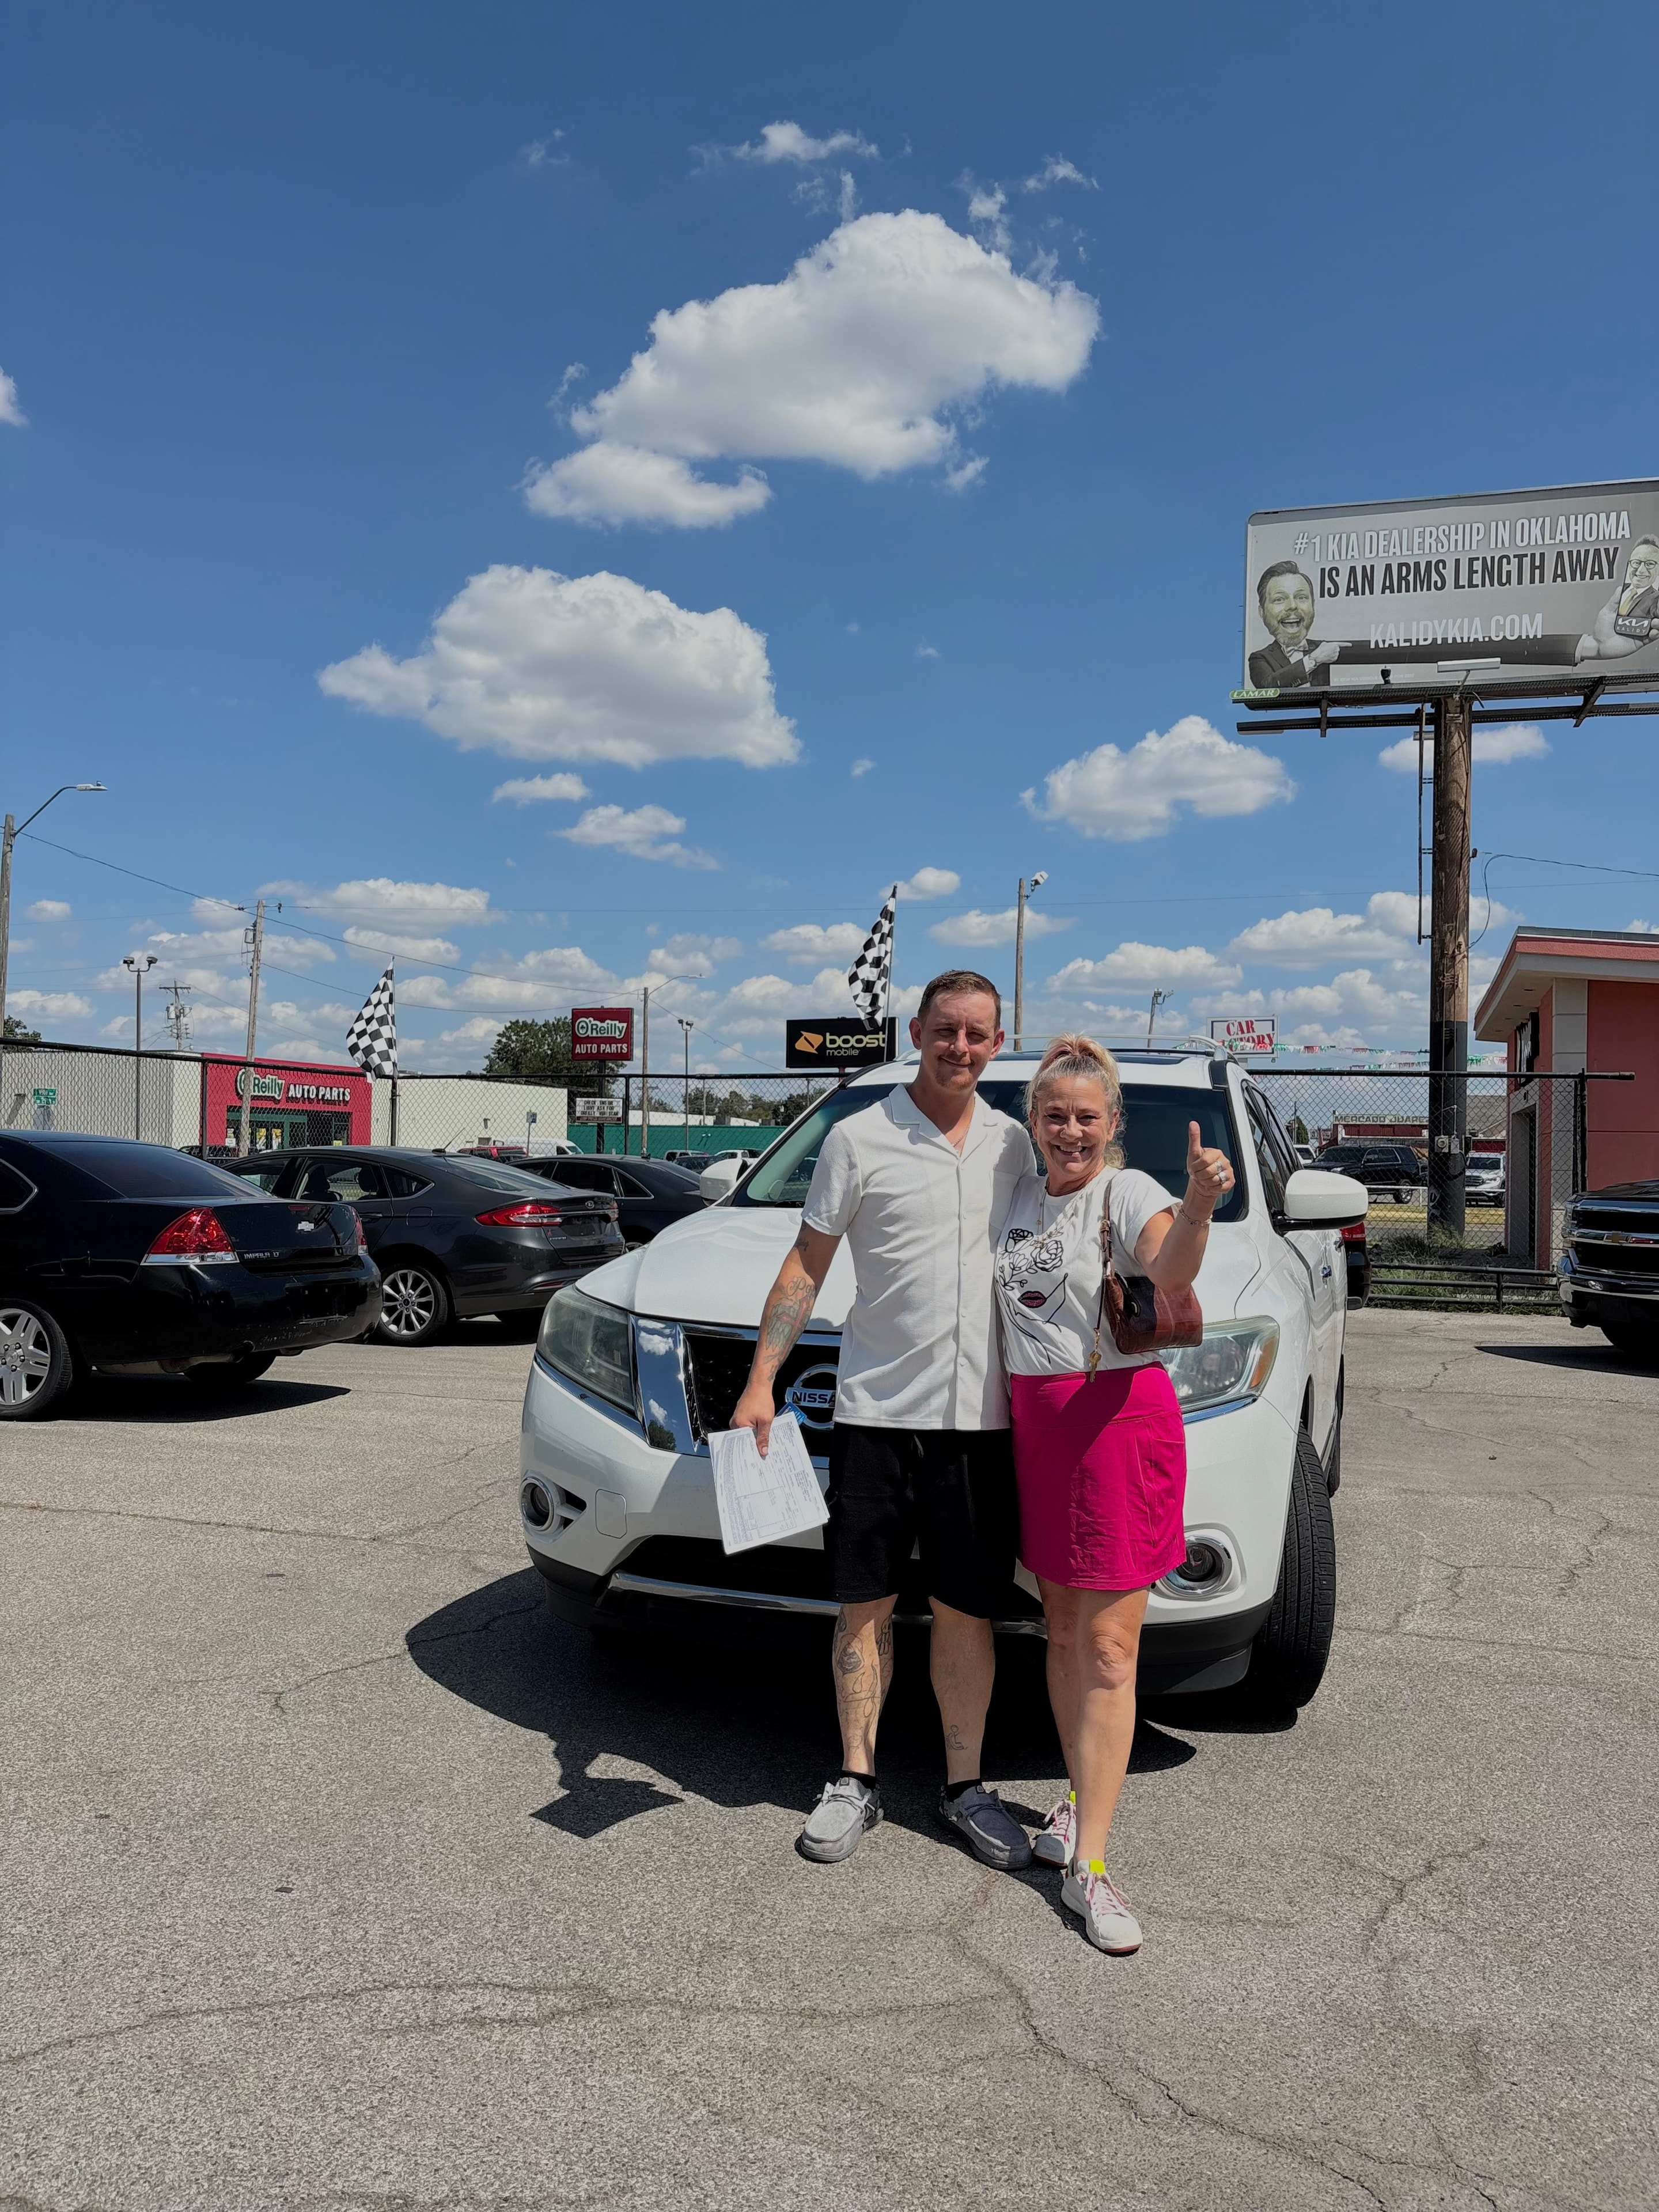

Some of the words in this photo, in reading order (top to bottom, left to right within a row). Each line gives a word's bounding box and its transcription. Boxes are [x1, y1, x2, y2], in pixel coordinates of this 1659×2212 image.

[1294, 532, 1321, 562] #1
[1327, 532, 1359, 561] KIA
[1364, 522, 1484, 559] DEALERSHIP
[1490, 520, 1510, 549] IN
[1515, 510, 1631, 547] OKLAHOMA
[1319, 566, 1340, 599] IS
[1345, 564, 1375, 597] AN
[1380, 558, 1447, 595] ARMS
[1453, 551, 1546, 590] LENGTH
[1552, 546, 1619, 584] AWAY
[1369, 612, 1543, 649] KALIDYKIA.COM
[1233, 690, 1275, 698] LAMAR
[576, 1018, 626, 1038] O'Reilly
[1226, 1020, 1256, 1036] CAR
[825, 1031, 886, 1048] boost
[575, 1043, 598, 1054] AUTO
[600, 1043, 628, 1054] PARTS
[825, 1048, 859, 1056] mobile
[288, 1083, 317, 1098] AUTO
[319, 1086, 351, 1101] PARTS
[1334, 1115, 1386, 1123] MERCADO
[792, 1391, 836, 1404] NISSA
